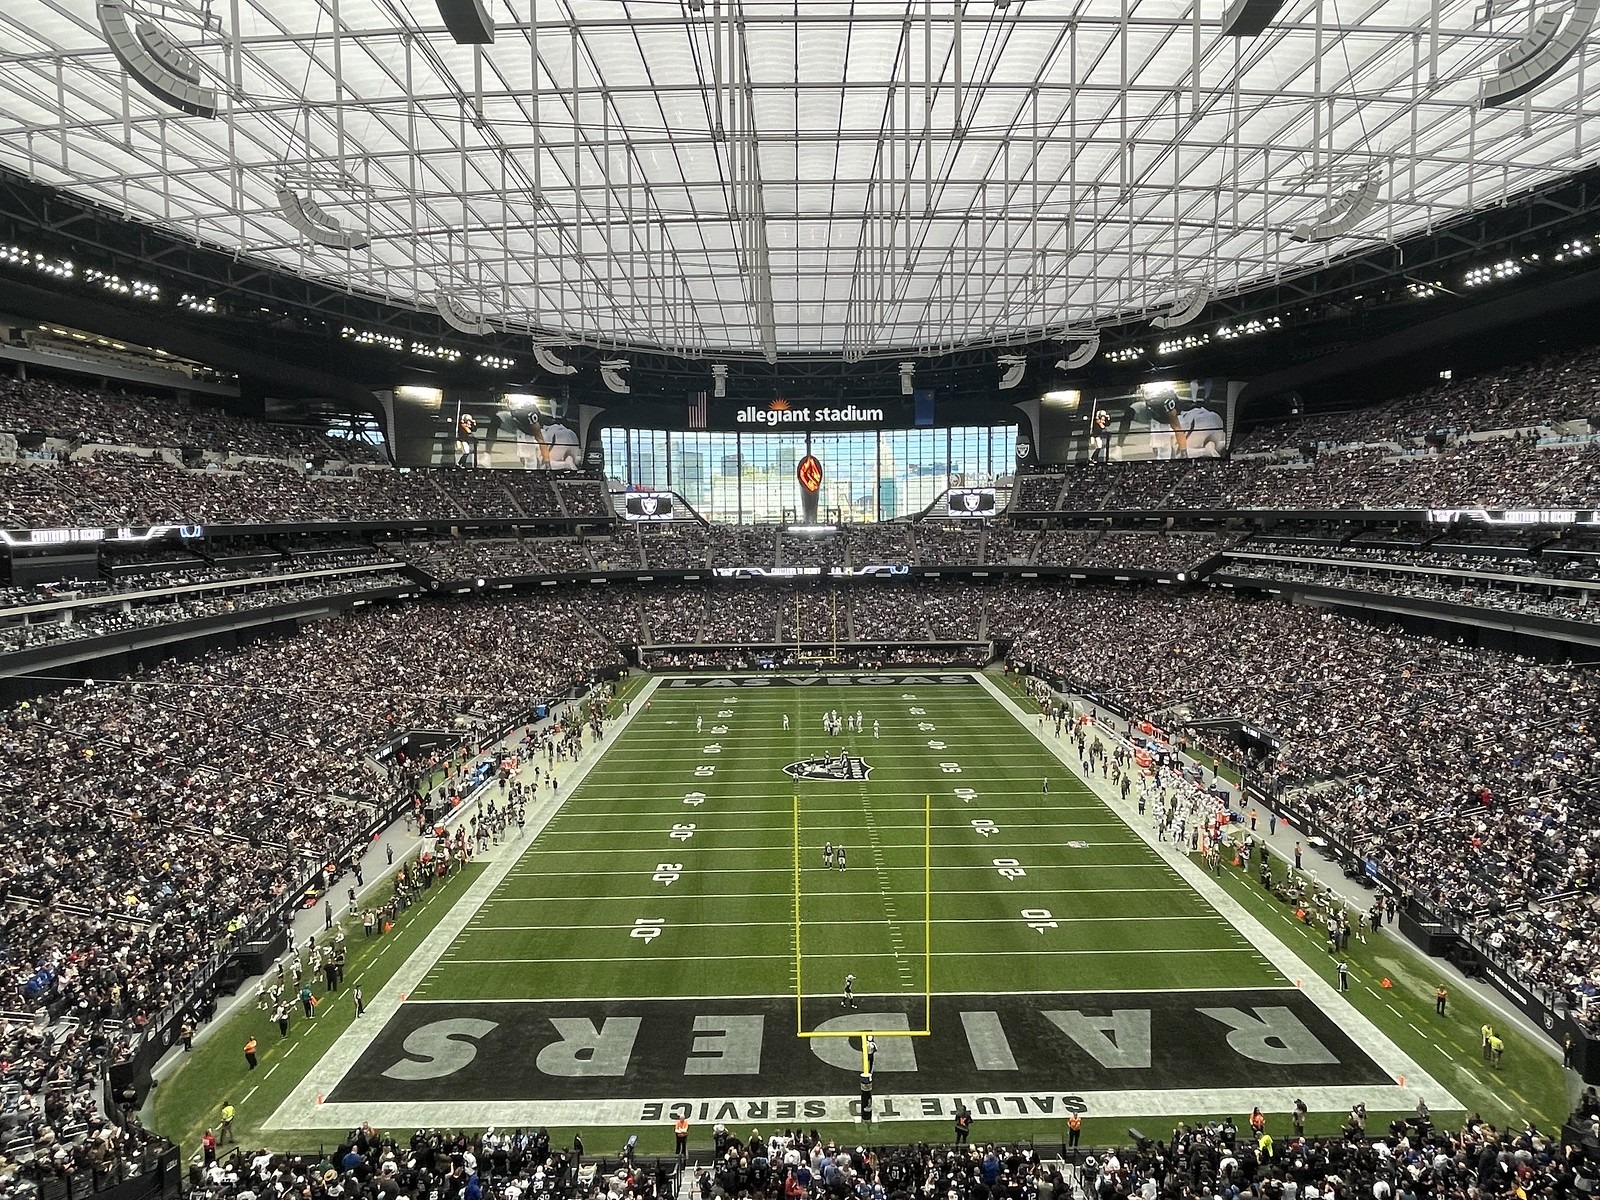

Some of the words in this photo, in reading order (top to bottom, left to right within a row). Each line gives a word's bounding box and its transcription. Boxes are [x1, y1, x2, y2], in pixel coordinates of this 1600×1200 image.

[737, 406, 810, 425] allegiant
[815, 405, 883, 421] stadium
[670, 679, 771, 687] LAS
[785, 676, 968, 686] VEGAS
[694, 765, 716, 776] 50
[940, 763, 962, 773] 50
[683, 792, 706, 804] 40
[953, 788, 978, 799] 40
[669, 823, 697, 838] 30
[970, 819, 1000, 834] 30
[652, 863, 683, 881] 20
[992, 858, 1027, 876] 20
[1020, 909, 1058, 928] 10
[630, 918, 665, 938] 10
[380, 1006, 1341, 1081] RAIDERS
[641, 1100, 827, 1121] SERVICE
[921, 1096, 1088, 1117] SALUTE
